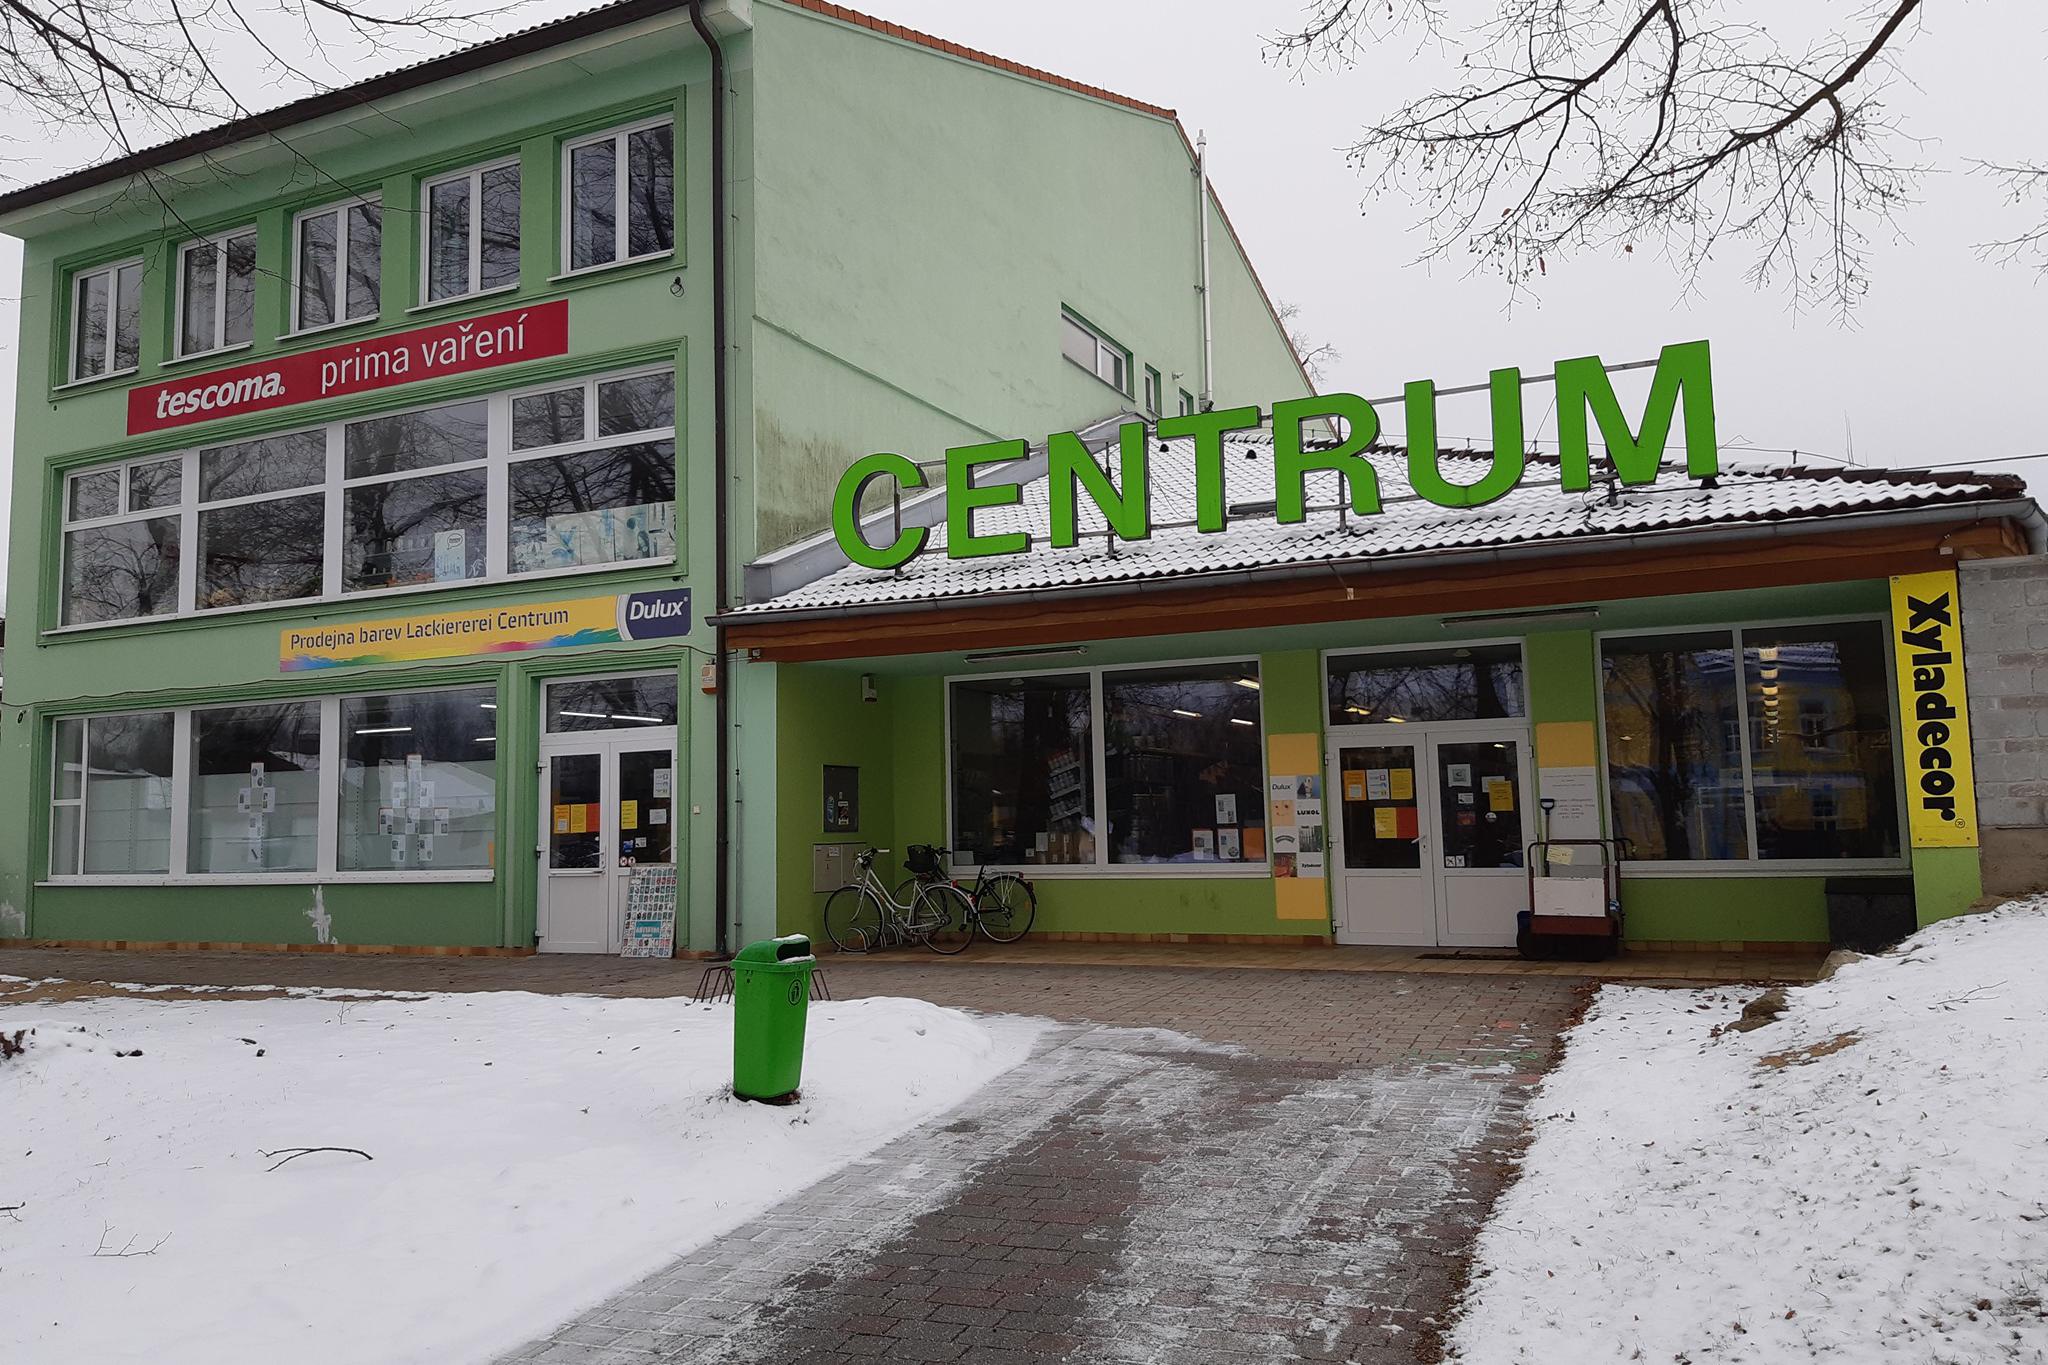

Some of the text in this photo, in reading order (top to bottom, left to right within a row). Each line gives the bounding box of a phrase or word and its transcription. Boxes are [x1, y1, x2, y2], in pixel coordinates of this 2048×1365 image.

[321, 347, 409, 395] prima
[421, 313, 529, 368] vaření
[832, 339, 1719, 571] CENTRUM
[291, 609, 569, 650] Prodejna barev Lackiererei Centrum
